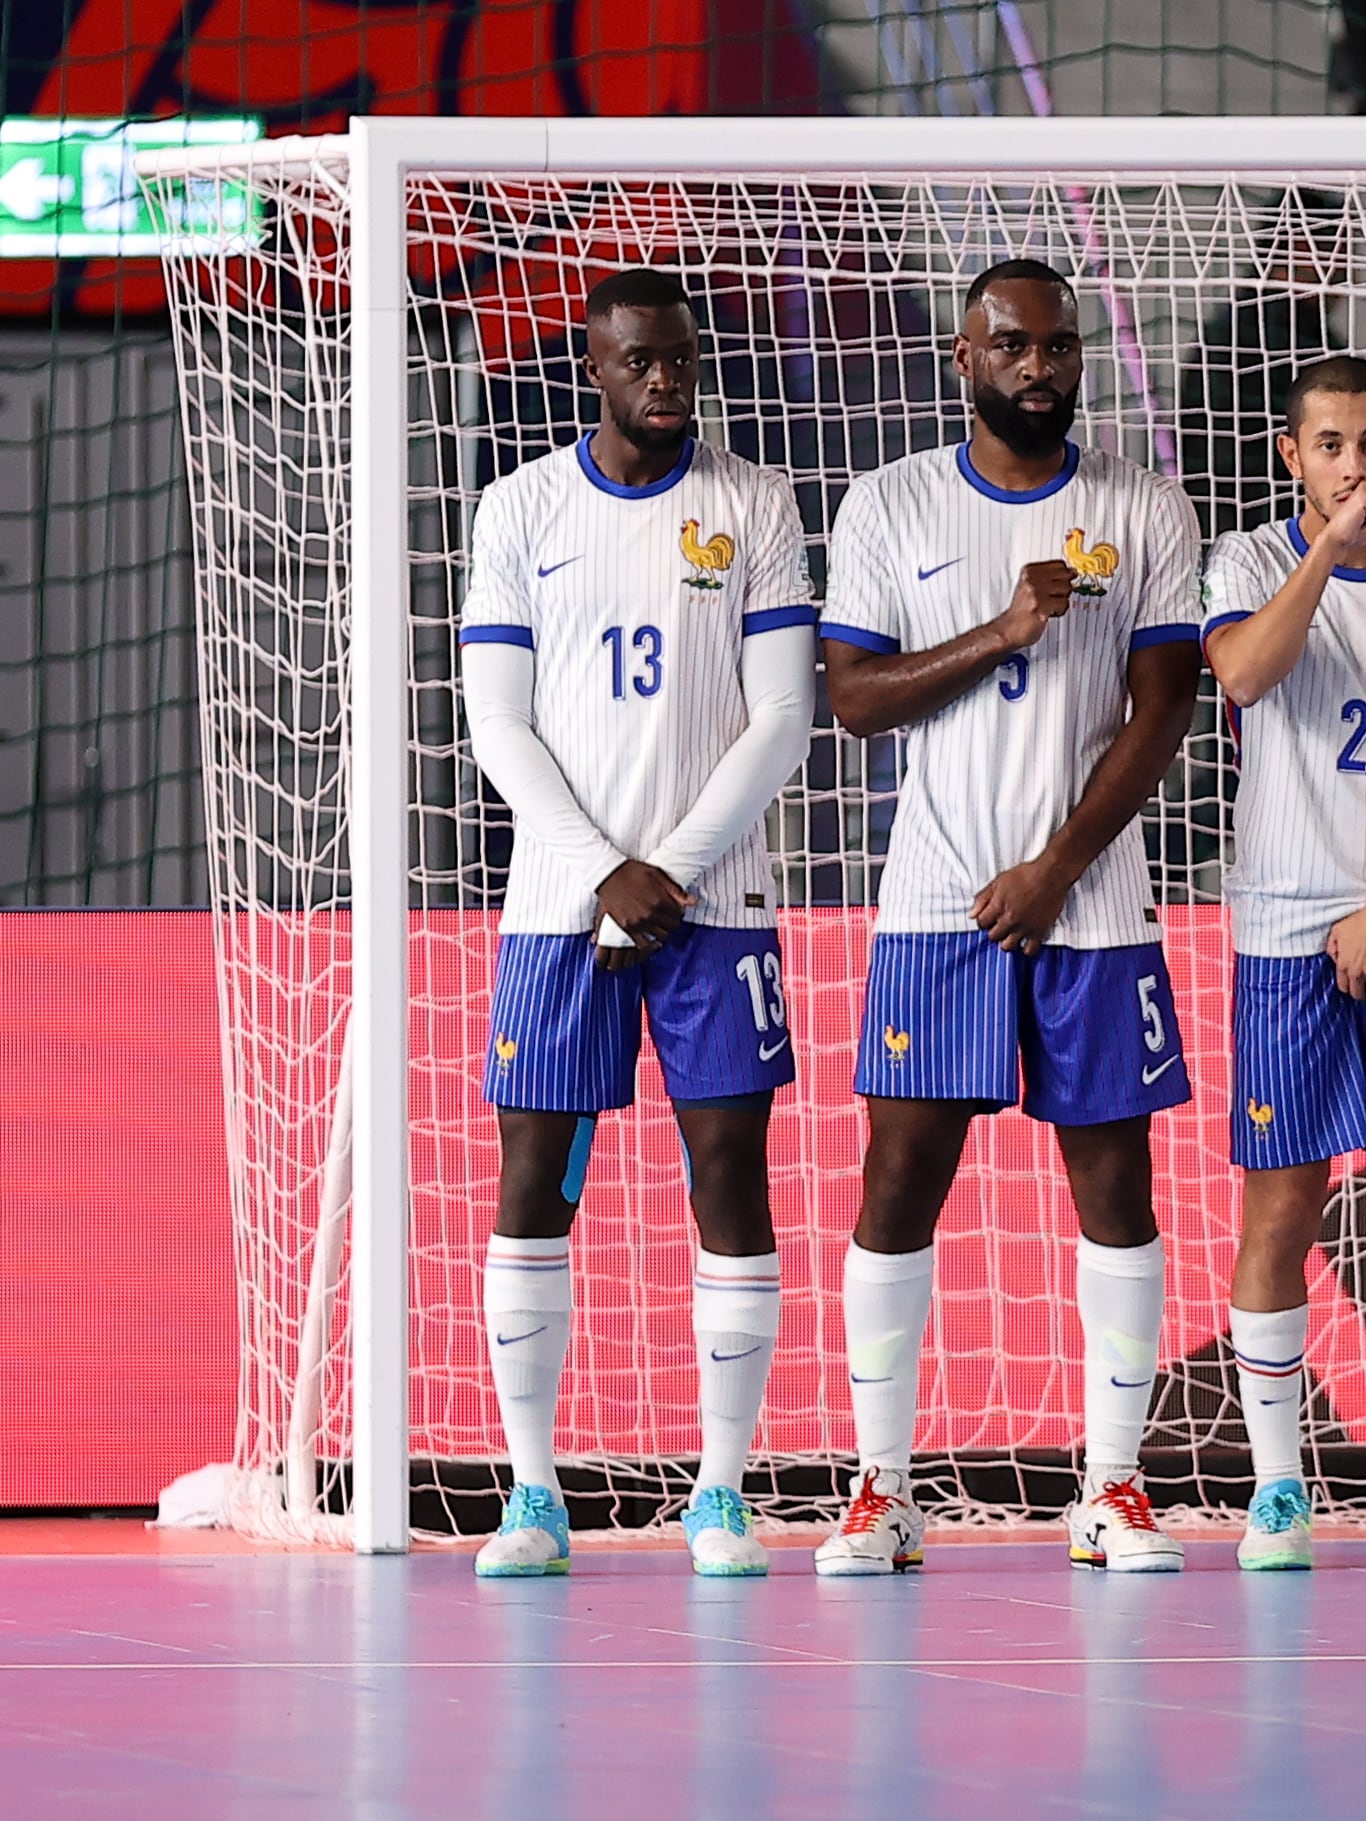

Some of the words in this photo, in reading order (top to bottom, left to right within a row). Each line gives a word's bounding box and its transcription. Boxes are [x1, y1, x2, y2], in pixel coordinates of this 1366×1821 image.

[602, 625, 665, 701] 13
[736, 951, 786, 1031] 13
[1137, 974, 1166, 1053] 5
